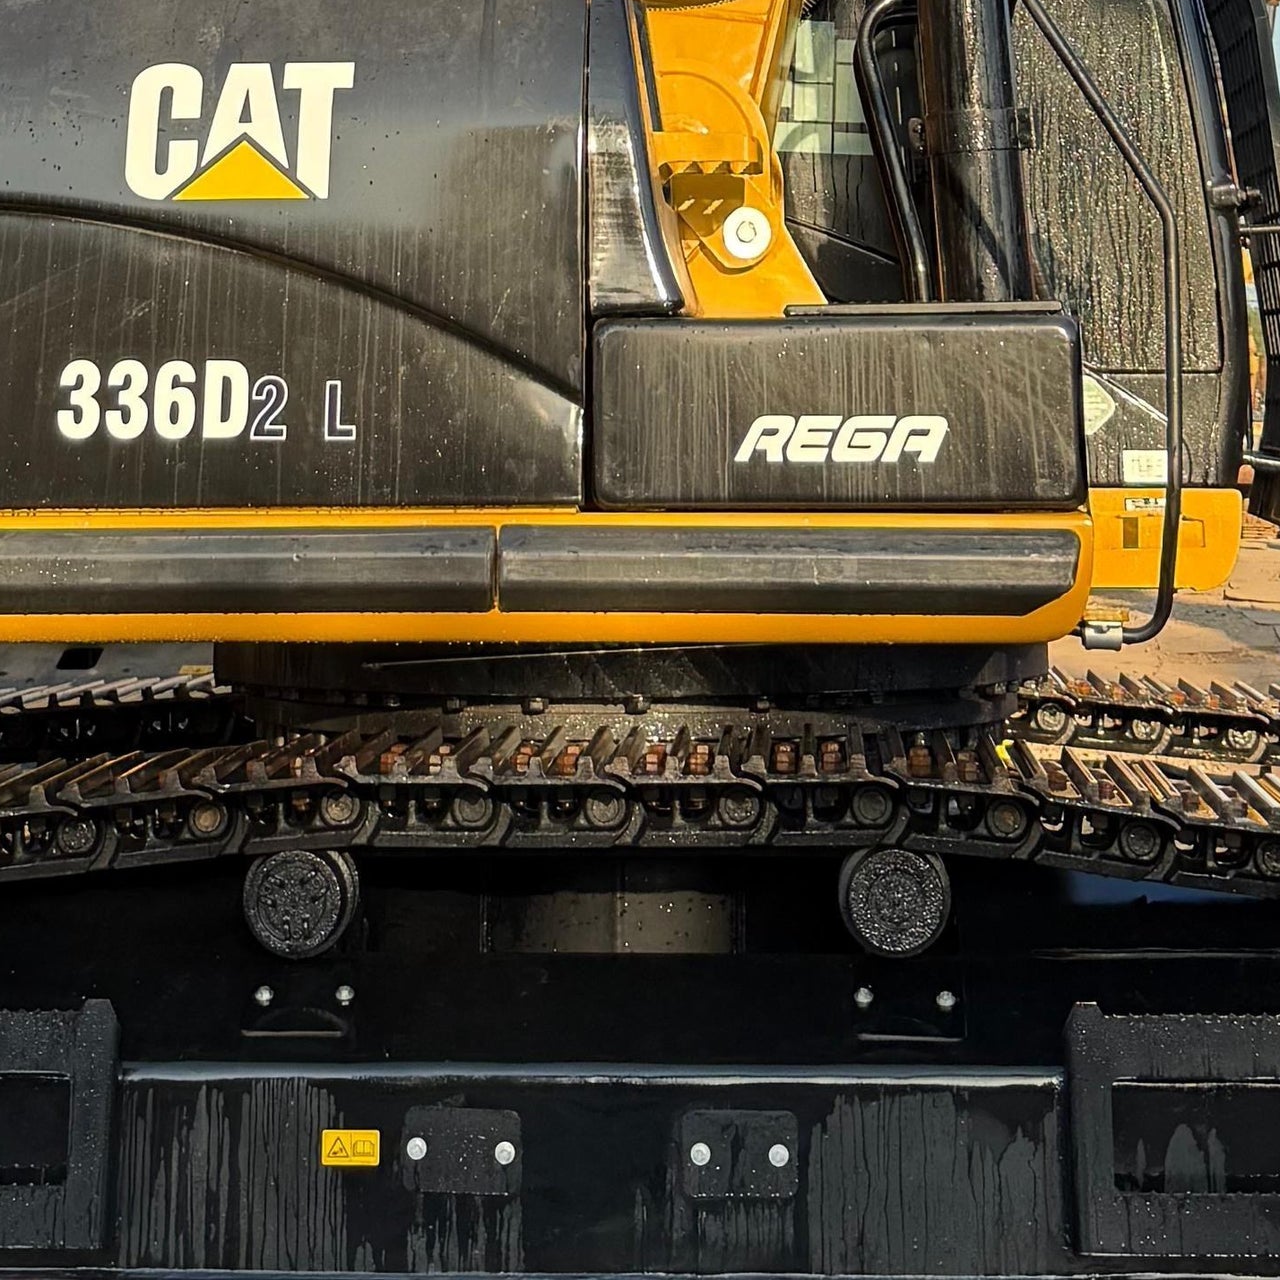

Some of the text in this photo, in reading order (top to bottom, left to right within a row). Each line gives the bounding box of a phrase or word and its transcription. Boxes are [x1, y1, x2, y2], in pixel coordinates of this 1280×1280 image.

[124, 61, 356, 201] CAT
[323, 379, 357, 442] L
[733, 414, 950, 464] REGA
